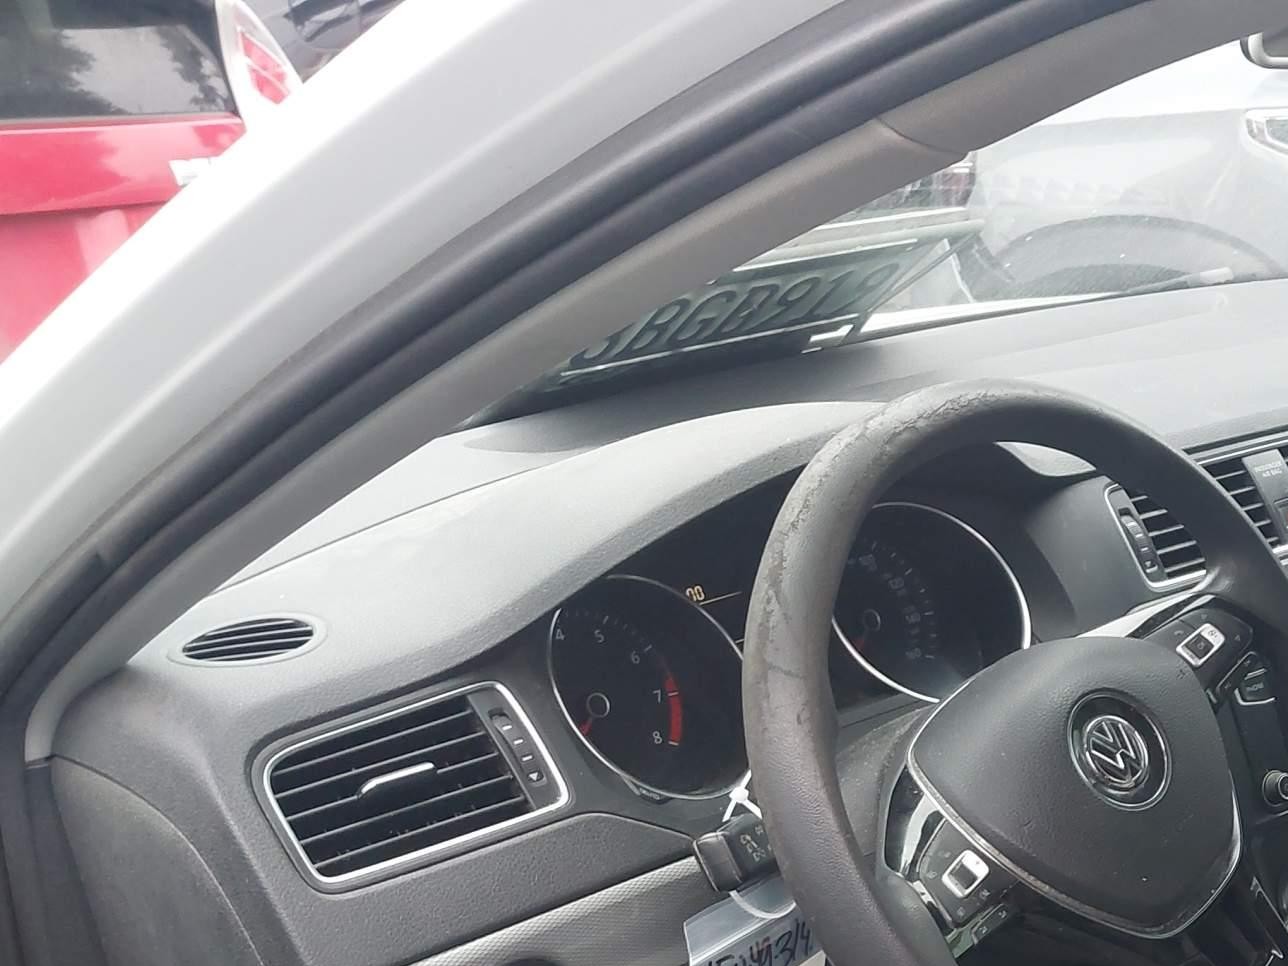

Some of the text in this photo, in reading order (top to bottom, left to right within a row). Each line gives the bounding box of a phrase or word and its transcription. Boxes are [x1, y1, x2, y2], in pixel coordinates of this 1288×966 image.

[556, 629, 565, 641] 4
[595, 630, 605, 643] 5
[631, 651, 640, 664] 6
[653, 690, 662, 703] 7
[653, 731, 663, 744] 8
